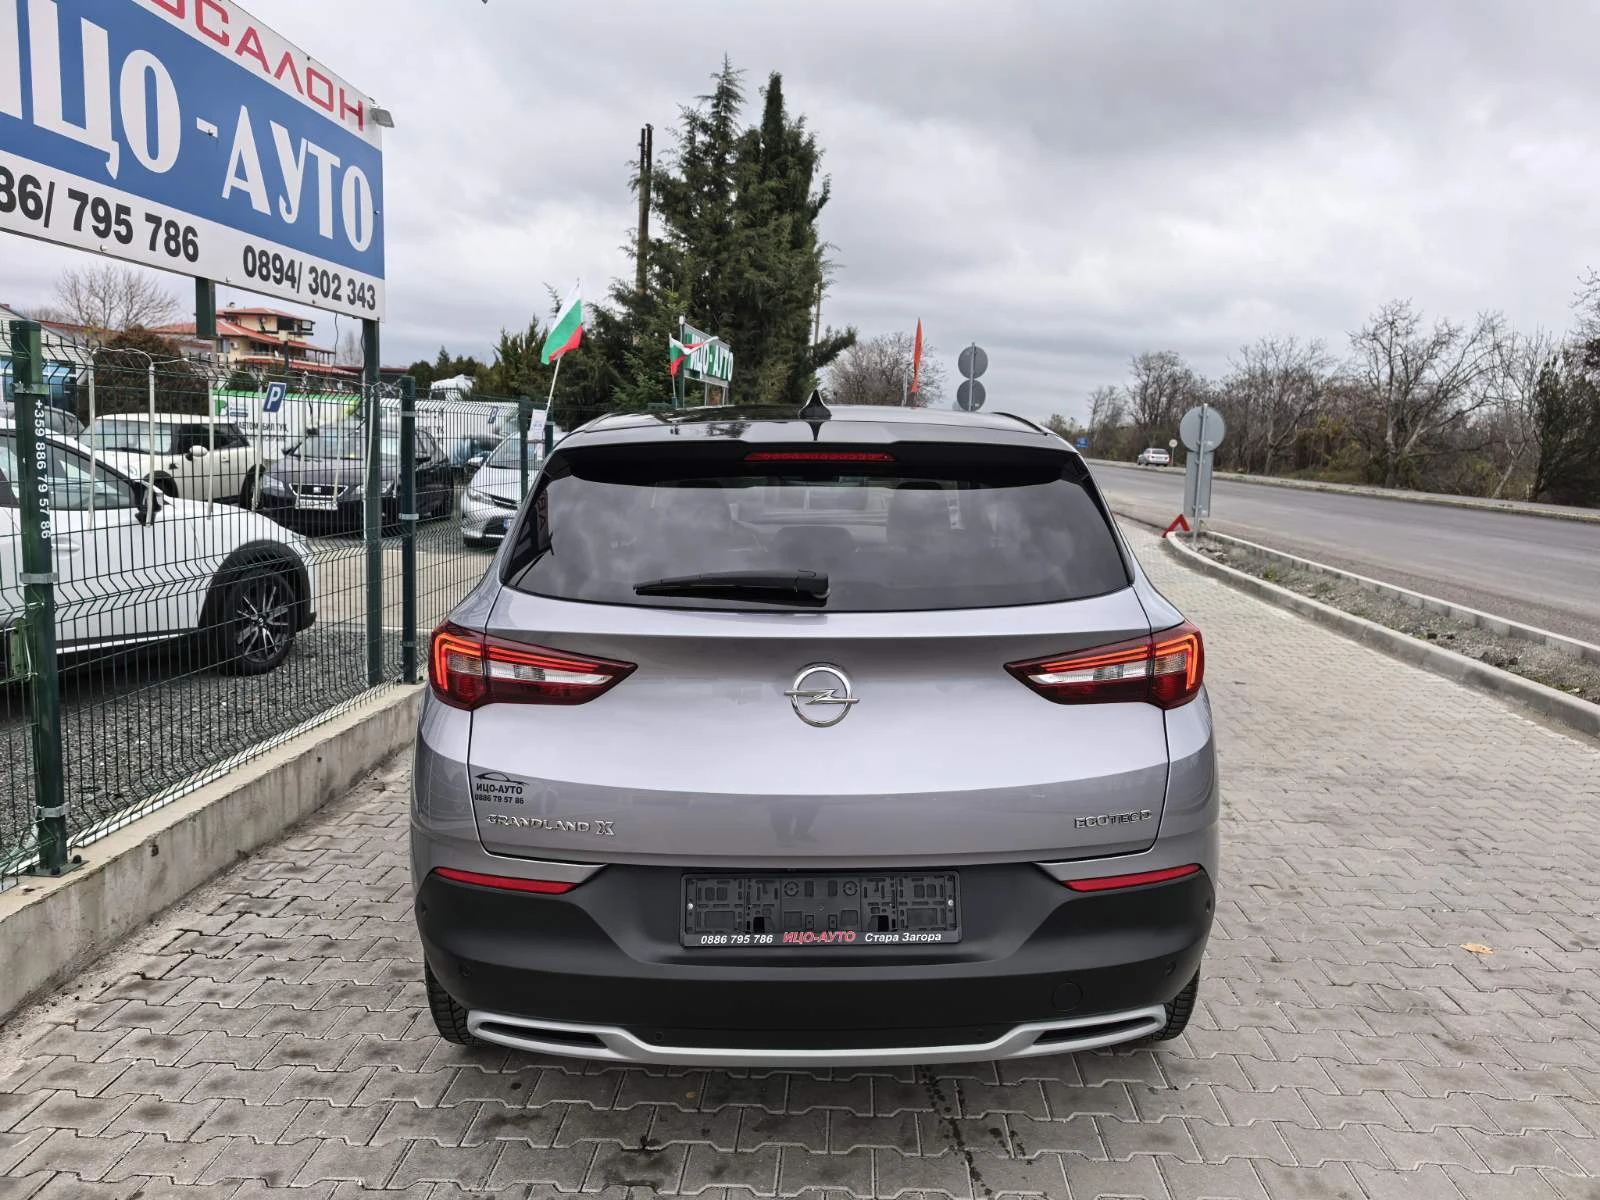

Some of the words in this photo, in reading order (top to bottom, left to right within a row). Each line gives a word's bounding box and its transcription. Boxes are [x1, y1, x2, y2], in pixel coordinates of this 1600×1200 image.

[67, 187, 134, 245] 795
[145, 212, 200, 263] 786
[243, 245, 303, 294] 0894/
[308, 266, 342, 302] 302
[347, 278, 376, 311] 343
[34, 399, 46, 437] +359
[35, 441, 47, 470] 886
[37, 474, 49, 493] 79
[39, 500, 50, 517] 57
[40, 521, 51, 539] 86
[474, 794, 492, 802] 0886
[476, 783, 523, 795] ИЦО-АУТО
[487, 814, 591, 832] GRANDLAND
[594, 819, 615, 836] X
[700, 935, 727, 945] 0886
[731, 934, 751, 944] 795
[754, 934, 774, 944] 786
[783, 931, 857, 945] ИЦО-АУТО
[864, 932, 899, 944] Стара
[902, 932, 942, 942] Загора
